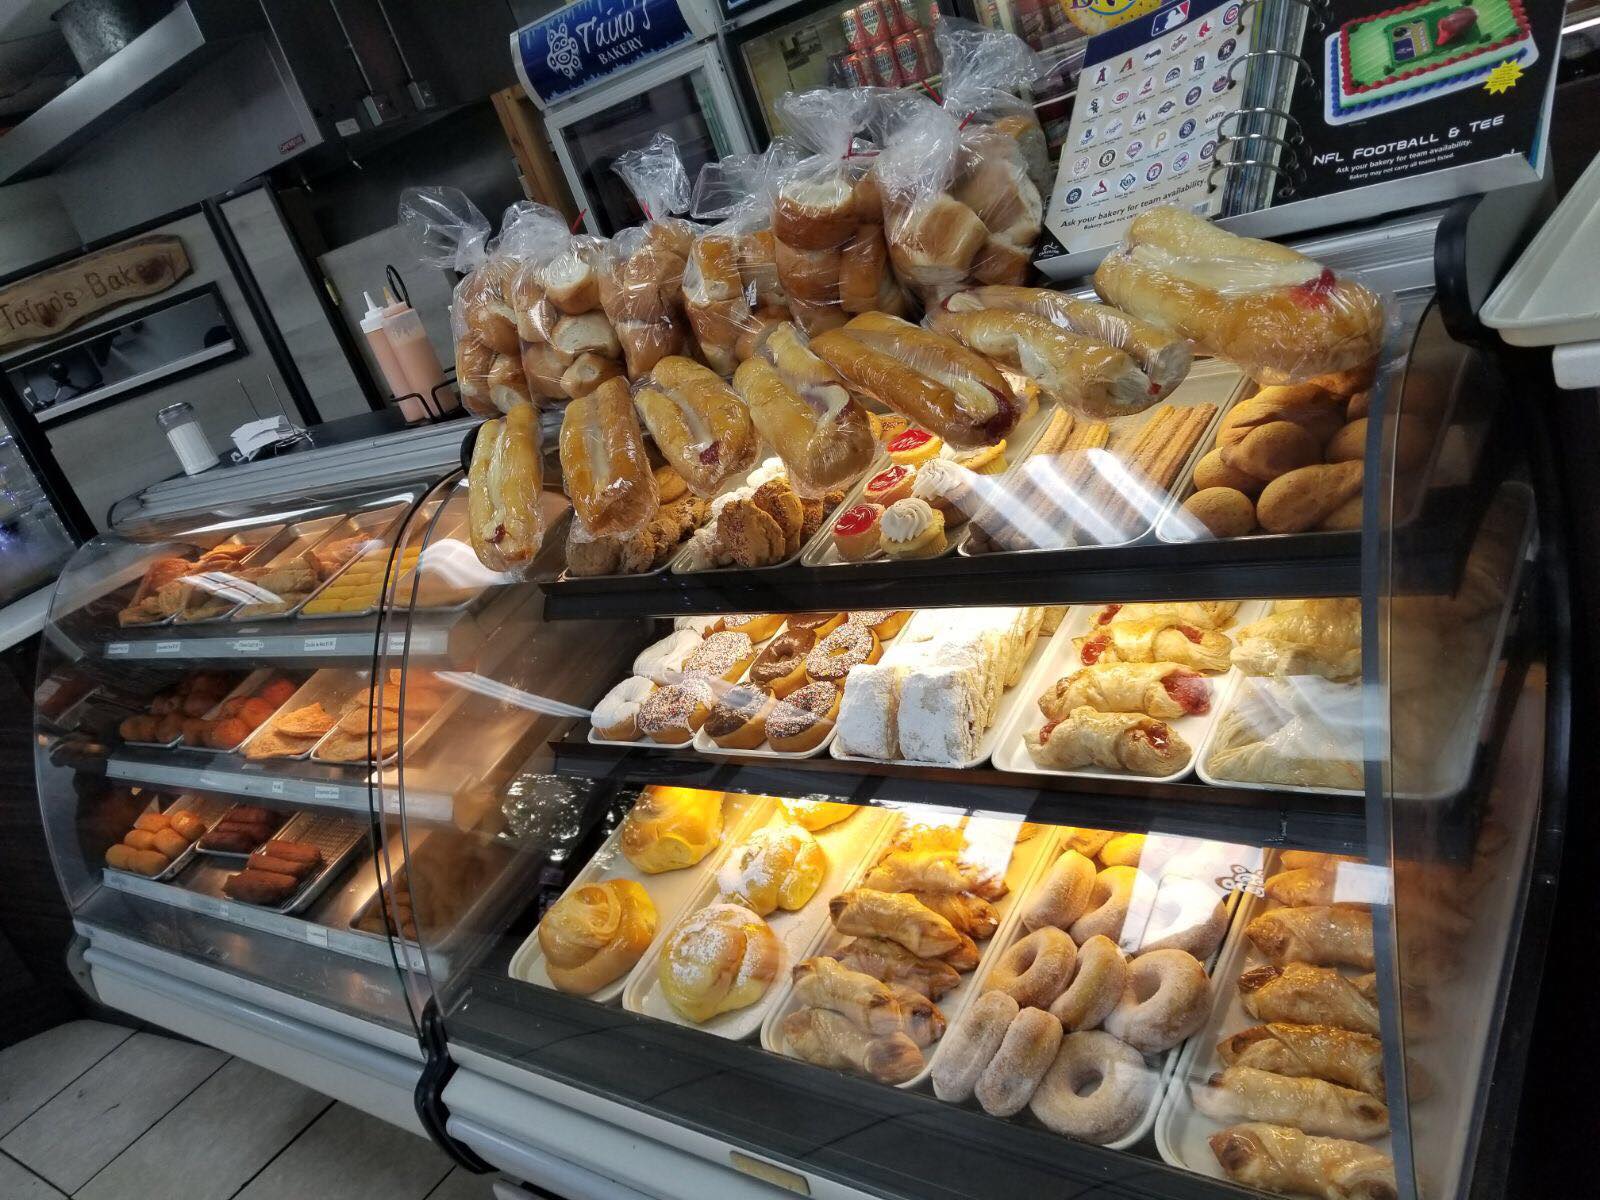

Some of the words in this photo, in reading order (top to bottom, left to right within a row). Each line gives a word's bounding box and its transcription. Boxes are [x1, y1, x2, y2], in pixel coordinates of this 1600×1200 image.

[597, 36, 644, 65] BAKERY
[1312, 152, 1344, 166] NFL
[1352, 133, 1439, 160] FOOTBALL
[1448, 127, 1460, 138] &
[1469, 114, 1505, 133] TEE
[1336, 165, 1349, 174] Ask
[1351, 163, 1368, 172] your
[1369, 157, 1394, 168] bakery
[1396, 154, 1408, 163] for
[1409, 150, 1428, 160] team
[1429, 139, 1473, 154] availability.
[1349, 171, 1368, 181] Bakery
[1370, 169, 1382, 177] may
[1383, 166, 1393, 174] not
[1394, 163, 1409, 172] carry
[1060, 219, 1076, 228] Ask
[1077, 216, 1097, 227] your
[1098, 207, 1125, 221] bakery
[1127, 202, 1139, 213] for
[1140, 196, 1162, 208] team
[84, 252, 180, 298] Baky
